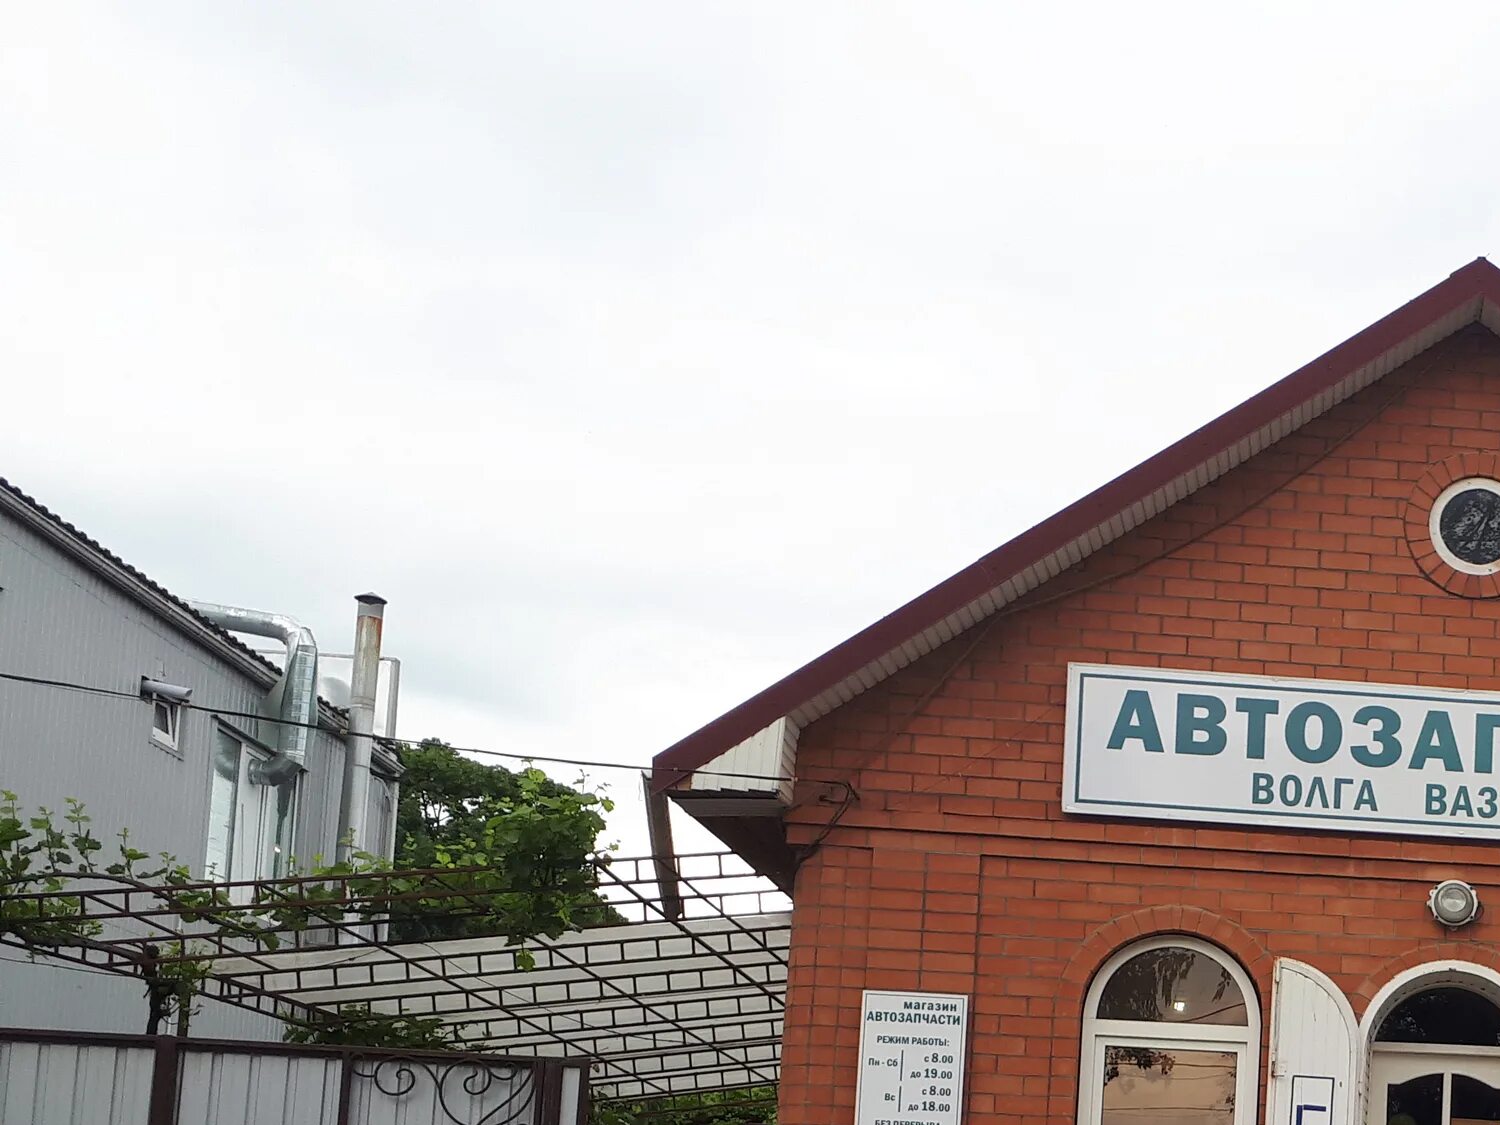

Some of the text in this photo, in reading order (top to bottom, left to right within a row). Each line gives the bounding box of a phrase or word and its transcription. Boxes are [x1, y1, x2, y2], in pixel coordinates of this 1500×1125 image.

[1252, 772, 1379, 814] ВОЛГА
[1424, 783, 1499, 819] ВАЗ
[903, 1001, 957, 1012] магазин
[866, 1011, 961, 1026] АВТОЗАПЧАСТИ
[876, 1035, 950, 1047] РЕЖИМ РАБОТЫ:
[868, 1057, 880, 1067] Пн
[886, 1058, 898, 1067] Сб
[931, 1052, 953, 1064] 8.00
[910, 1068, 953, 1080] до 19.00
[884, 1092, 896, 1102] Вс
[929, 1085, 951, 1097] 8.00
[907, 1100, 951, 1113] до 18.00
